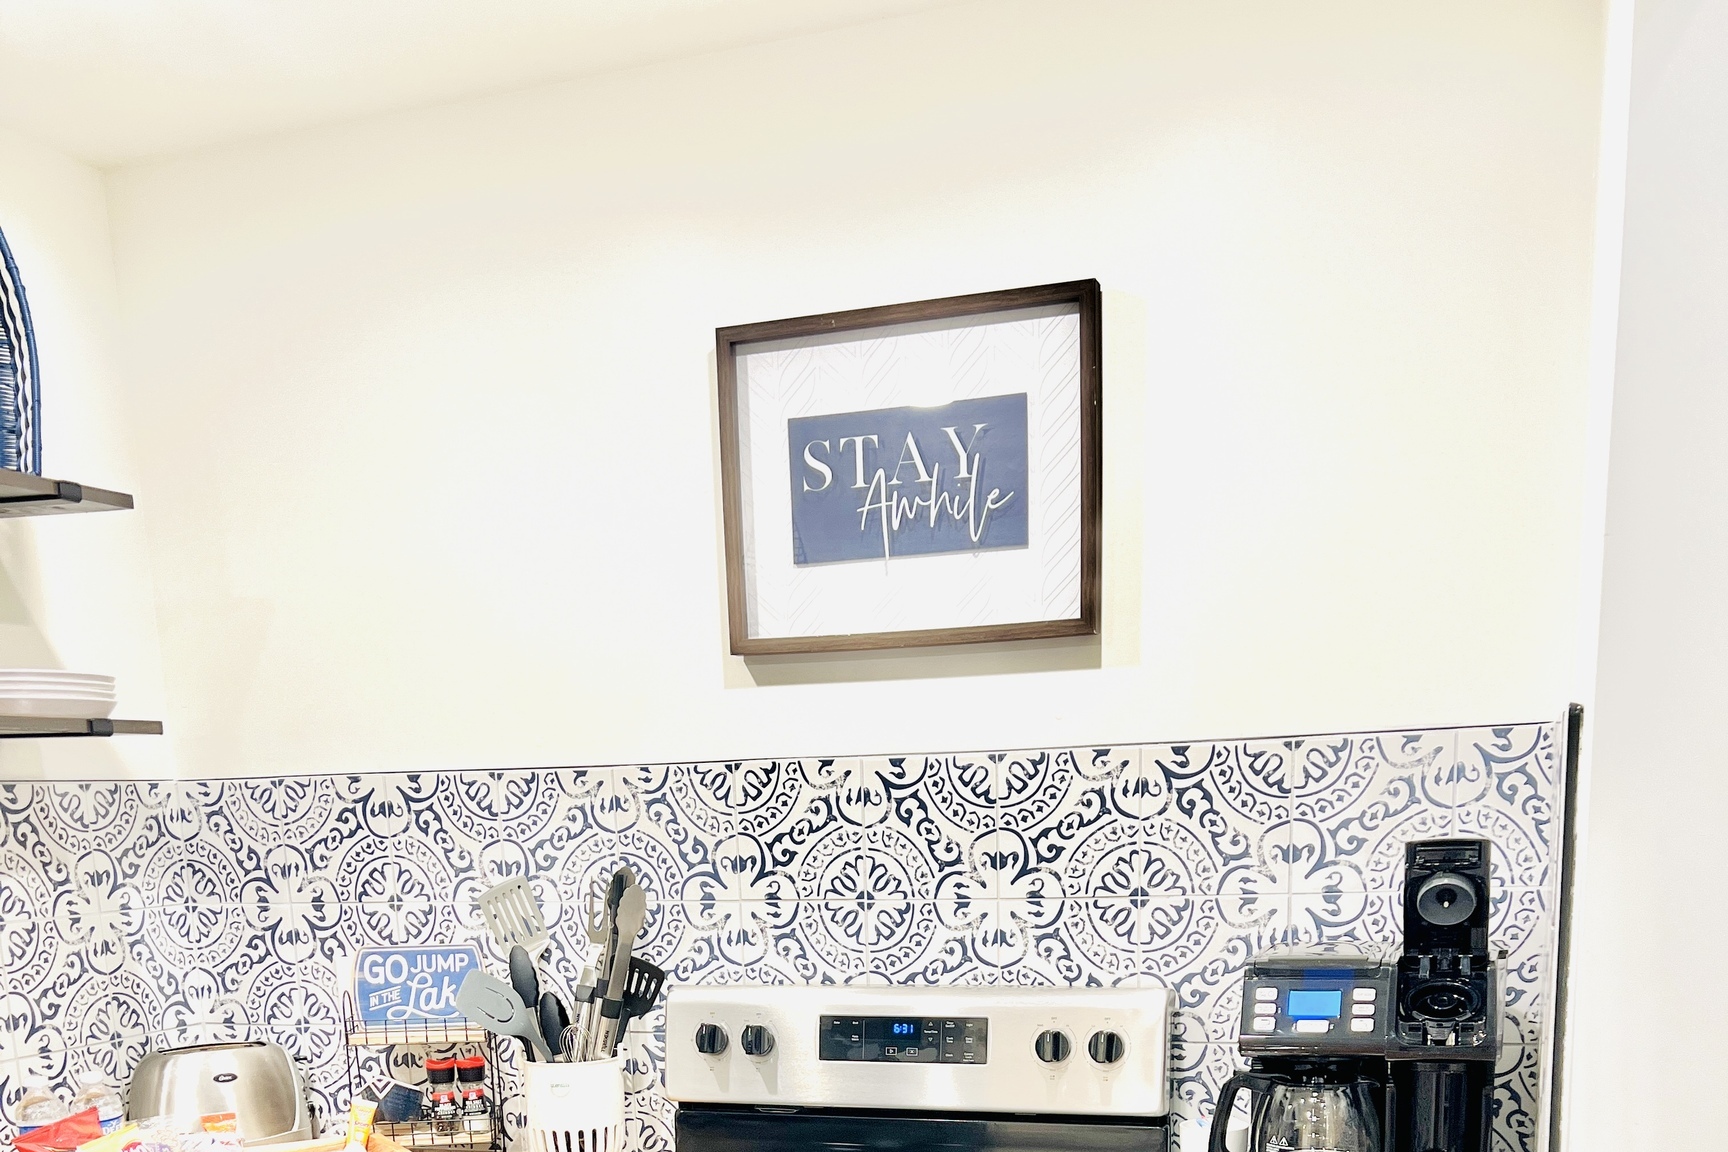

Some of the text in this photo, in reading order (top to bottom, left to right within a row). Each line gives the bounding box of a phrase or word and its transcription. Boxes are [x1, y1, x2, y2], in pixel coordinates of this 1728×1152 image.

[803, 422, 988, 493] STAY
[856, 453, 1015, 561] Awhile
[363, 953, 469, 985] GO JUMP
[369, 989, 401, 1007] IN THE
[386, 971, 461, 1022] Lak
[893, 1023, 914, 1034] 6:31
